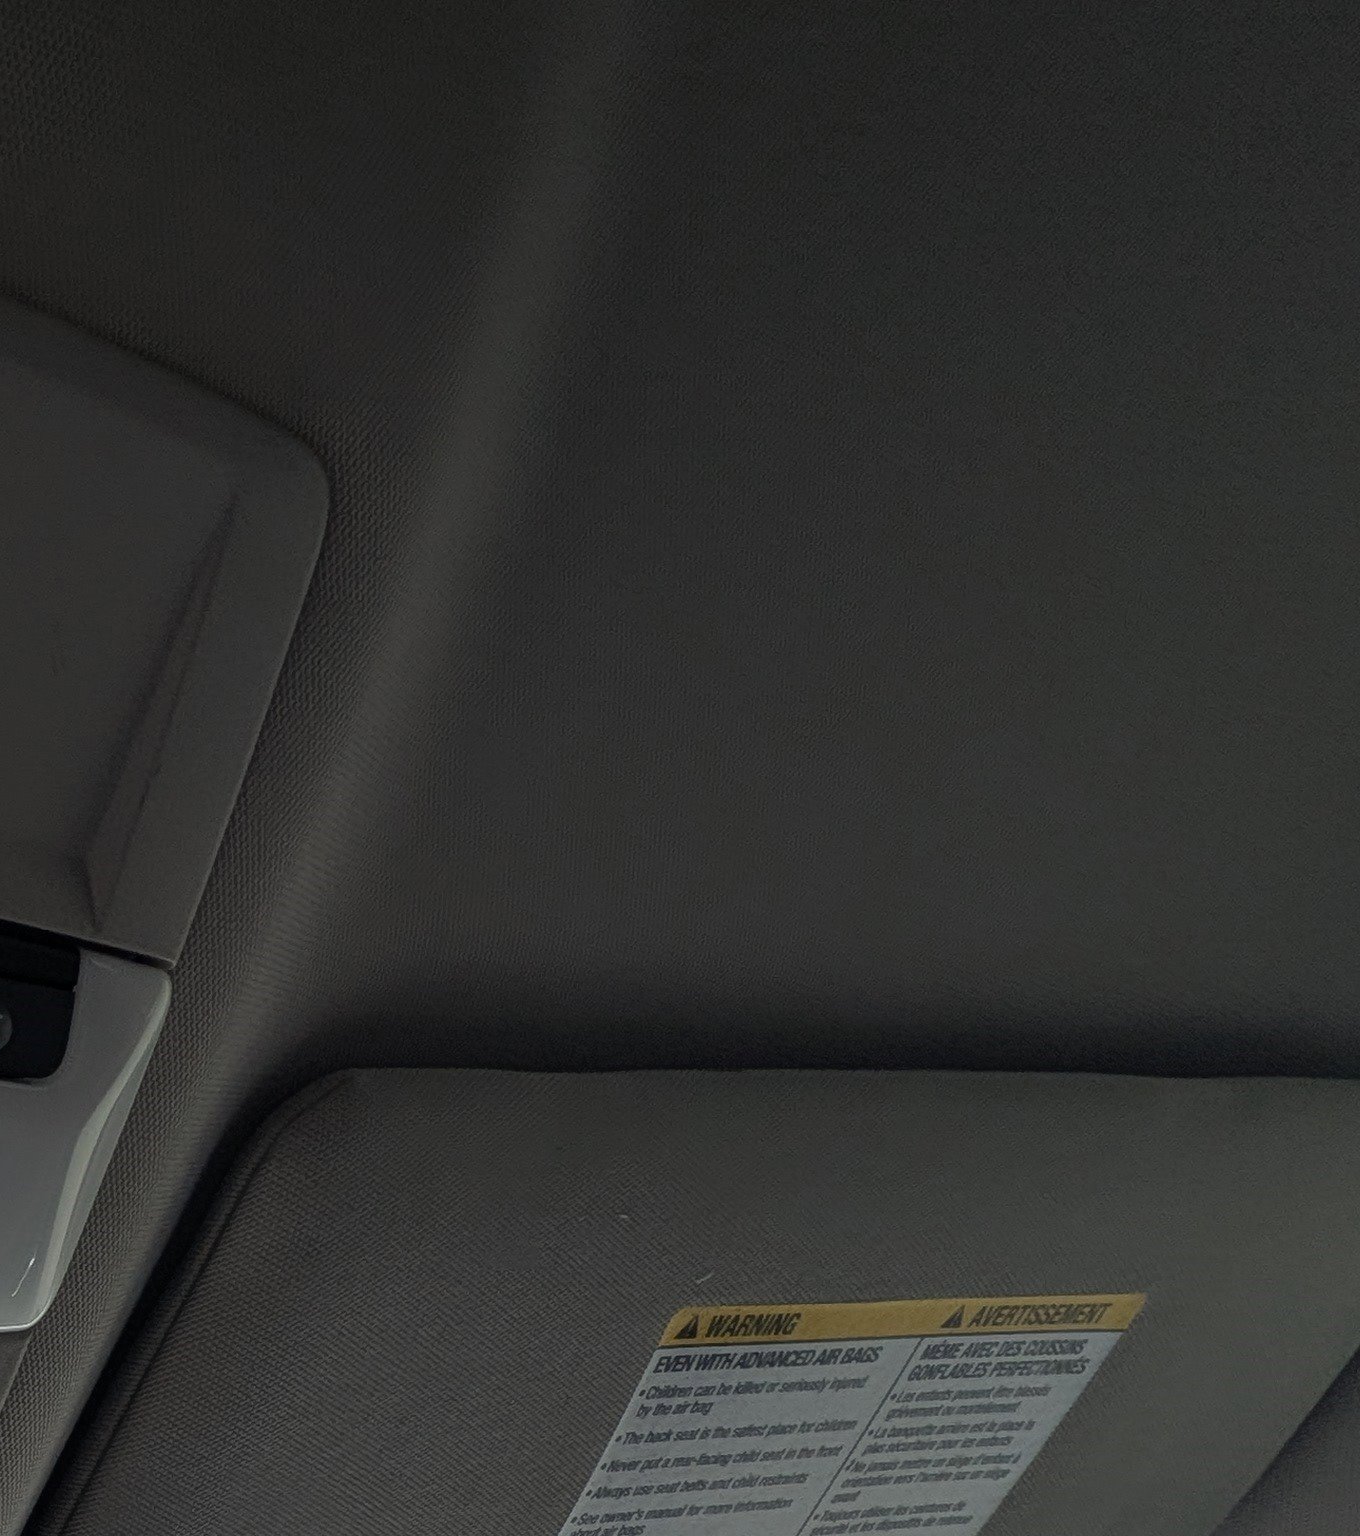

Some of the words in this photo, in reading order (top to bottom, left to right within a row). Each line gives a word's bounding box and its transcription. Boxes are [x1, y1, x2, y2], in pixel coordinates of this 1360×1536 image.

[966, 1301, 1114, 1327] AVERTISSEMENT
[701, 1312, 803, 1338] WARNING
[958, 1341, 1000, 1358] AVEC
[993, 1340, 1028, 1357] DES
[1019, 1338, 1091, 1356] COUSSINS
[651, 1354, 698, 1373] EVEN
[691, 1352, 739, 1371] WITH
[731, 1348, 819, 1369] ADVANCED
[811, 1347, 846, 1365] AIR
[837, 1346, 885, 1364] BAGS
[905, 1361, 994, 1381] GONFLABLES
[642, 1384, 696, 1400] Children
[691, 1385, 718, 1397] can
[714, 1382, 736, 1396] be
[633, 1403, 654, 1418] by
[650, 1402, 675, 1416] the
[670, 1401, 692, 1415] air
[686, 1400, 715, 1416] bag
[620, 1430, 647, 1444] The
[642, 1428, 676, 1443] back
[671, 1427, 701, 1441] seat
[763, 1422, 800, 1437] place
[604, 1458, 643, 1472] Never
[638, 1457, 664, 1472] put
[659, 1458, 672, 1468] a
[730, 1449, 763, 1463] child
[757, 1448, 787, 1461] seat
[589, 1484, 634, 1501] Always
[631, 1485, 655, 1495] use
[652, 1481, 682, 1494] seat
[575, 1511, 601, 1525] See
